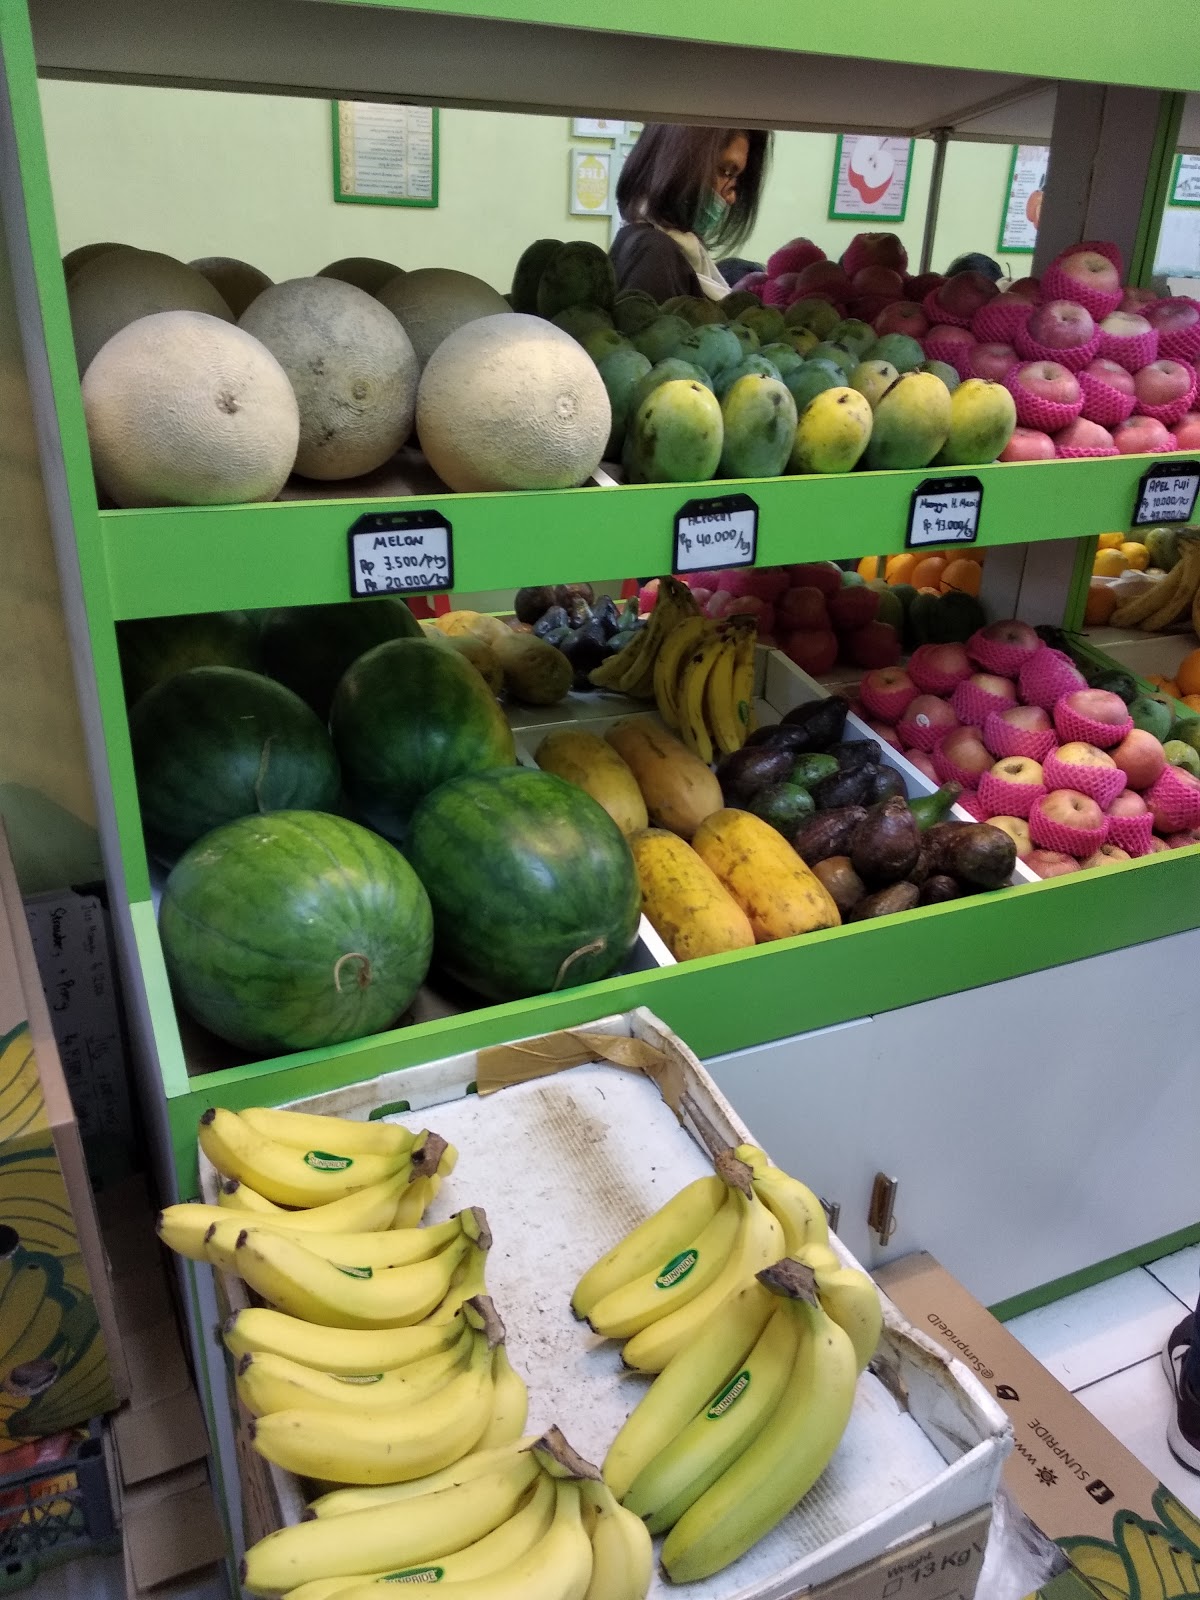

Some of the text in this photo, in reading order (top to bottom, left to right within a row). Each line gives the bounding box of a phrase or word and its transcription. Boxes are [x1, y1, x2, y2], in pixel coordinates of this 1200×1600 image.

[373, 535, 424, 550] MELON
[359, 559, 375, 576] Rp
[927, 1313, 994, 1379] @SunprideID
[1027, 1418, 1090, 1481] SUNPRIDE
